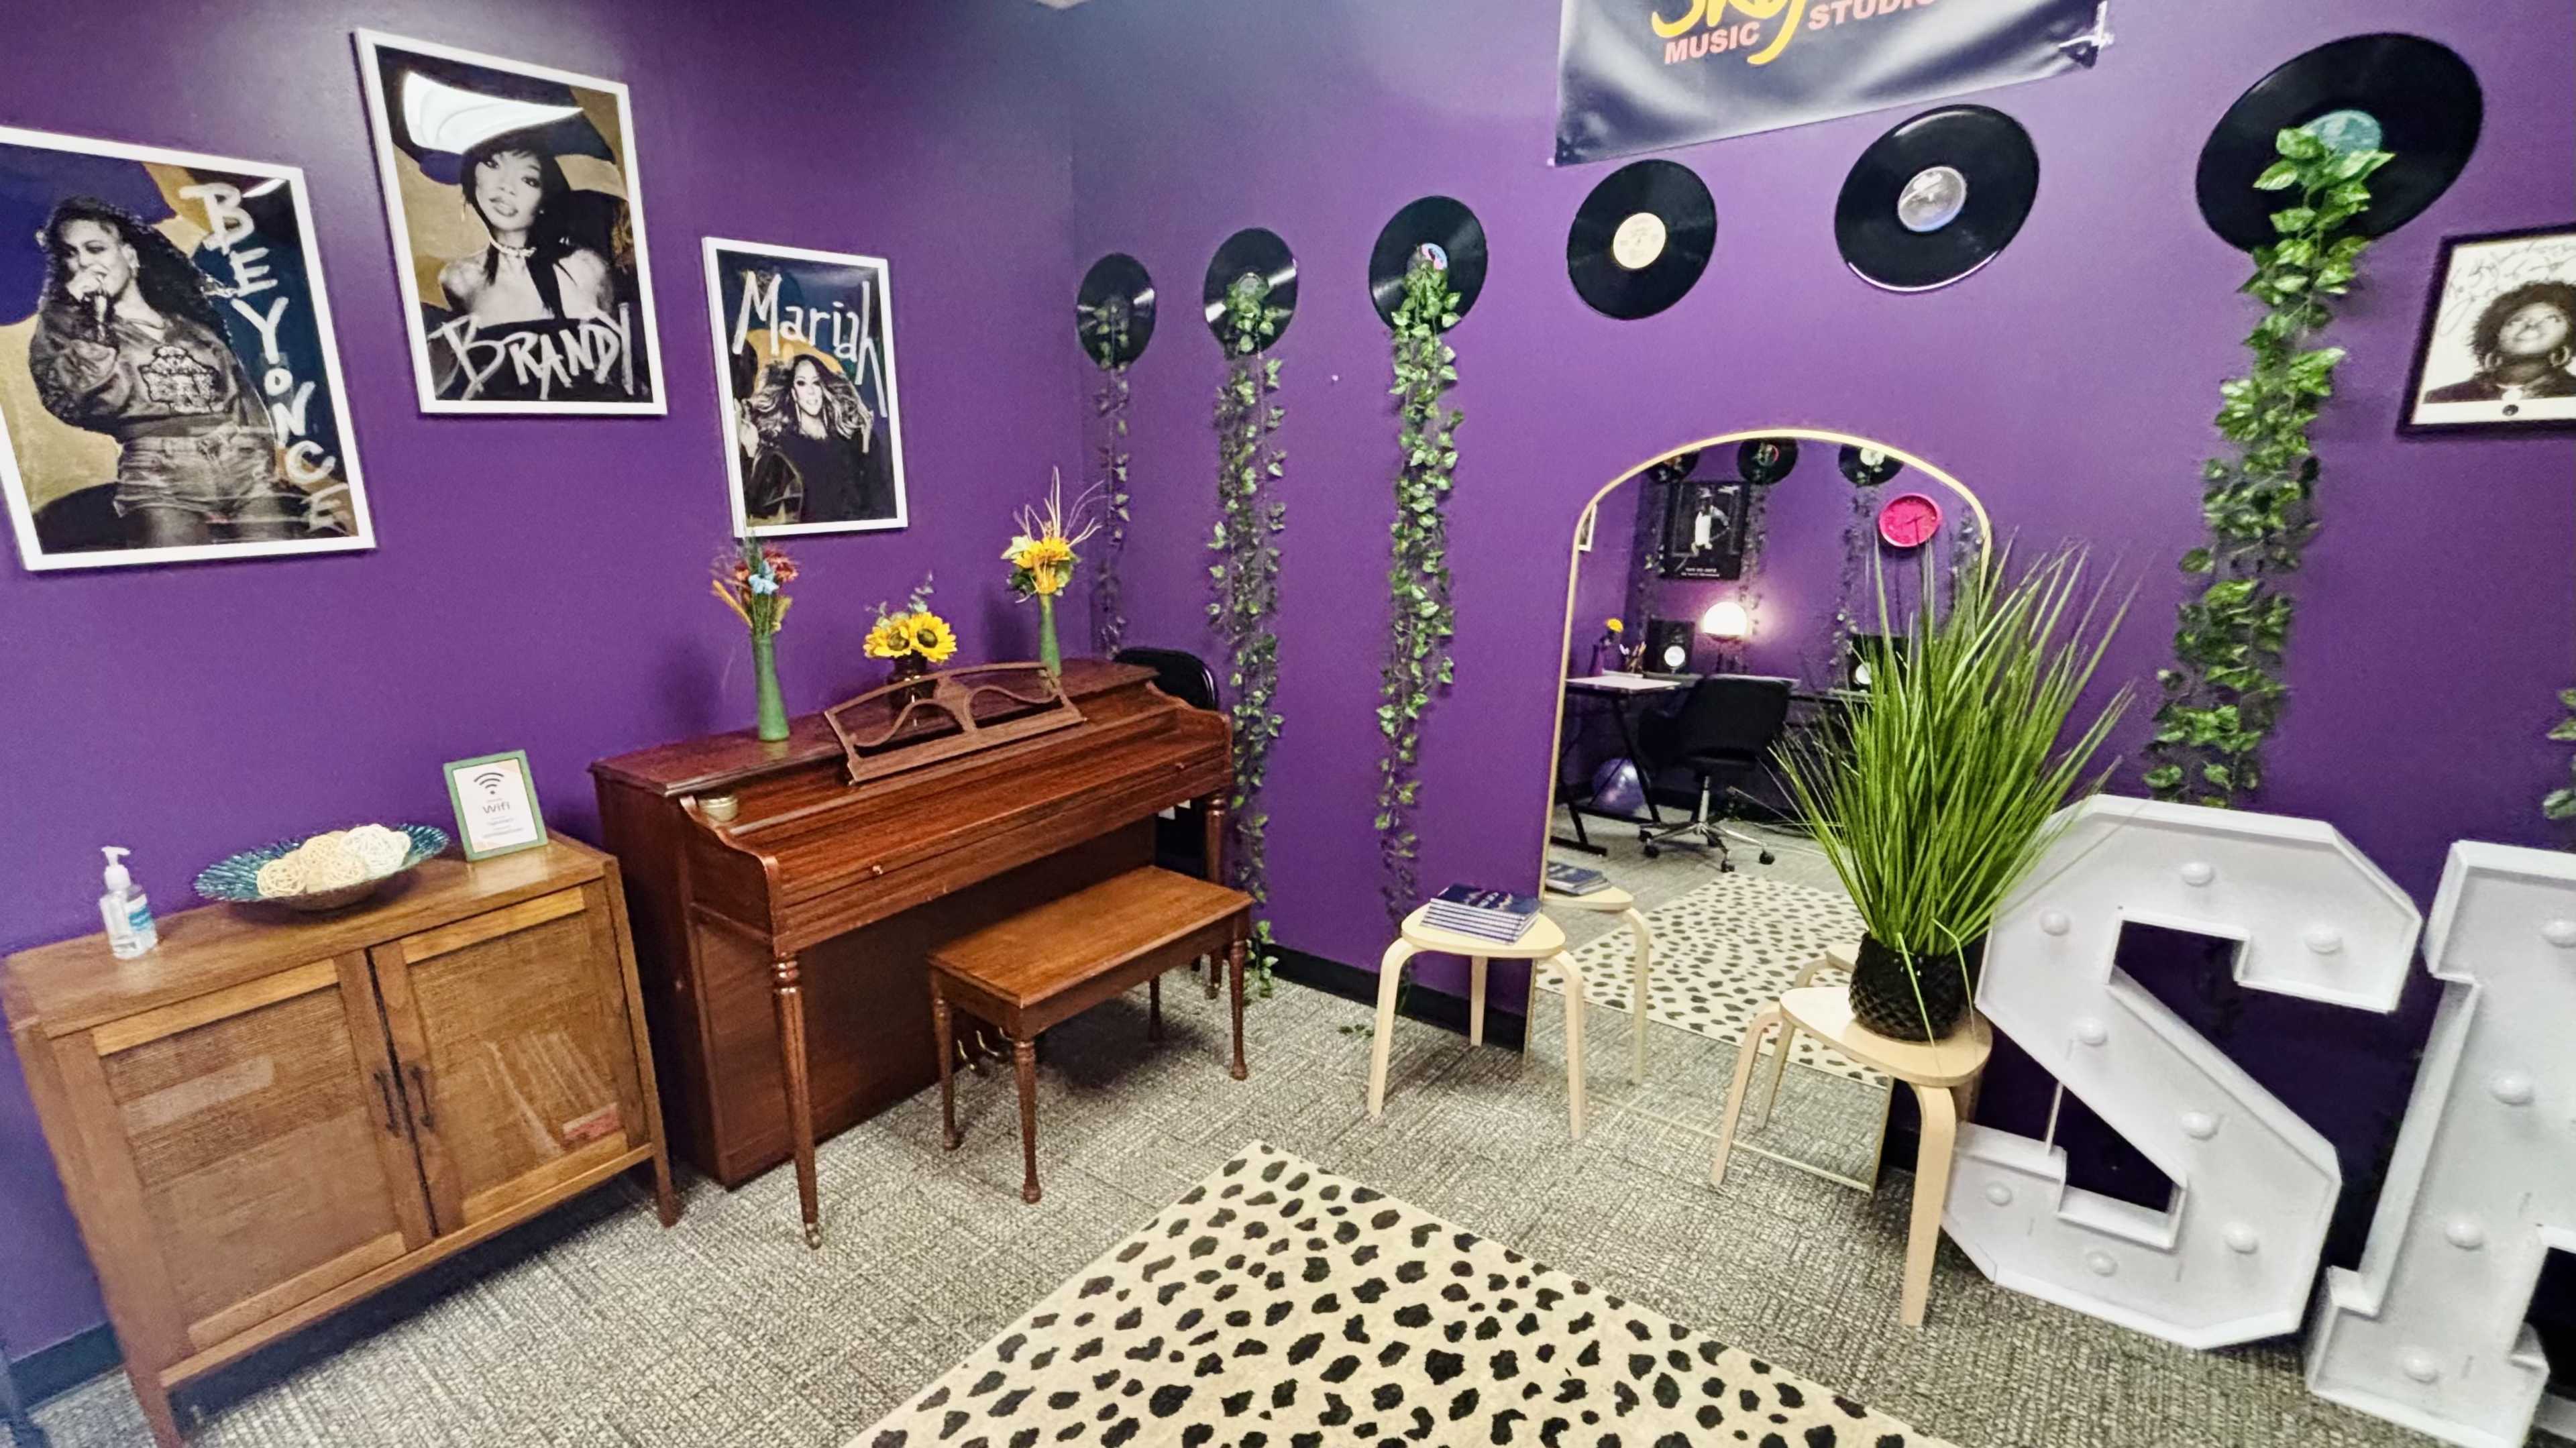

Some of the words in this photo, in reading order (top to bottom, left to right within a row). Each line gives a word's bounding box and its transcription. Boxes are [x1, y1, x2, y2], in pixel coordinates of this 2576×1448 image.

[1664, 21, 1760, 64] MUSIC
[1808, 0, 1935, 30] STUD
[427, 302, 634, 400] BRANDY
[732, 270, 888, 418] Mariah
[482, 801, 511, 814] Wifi
